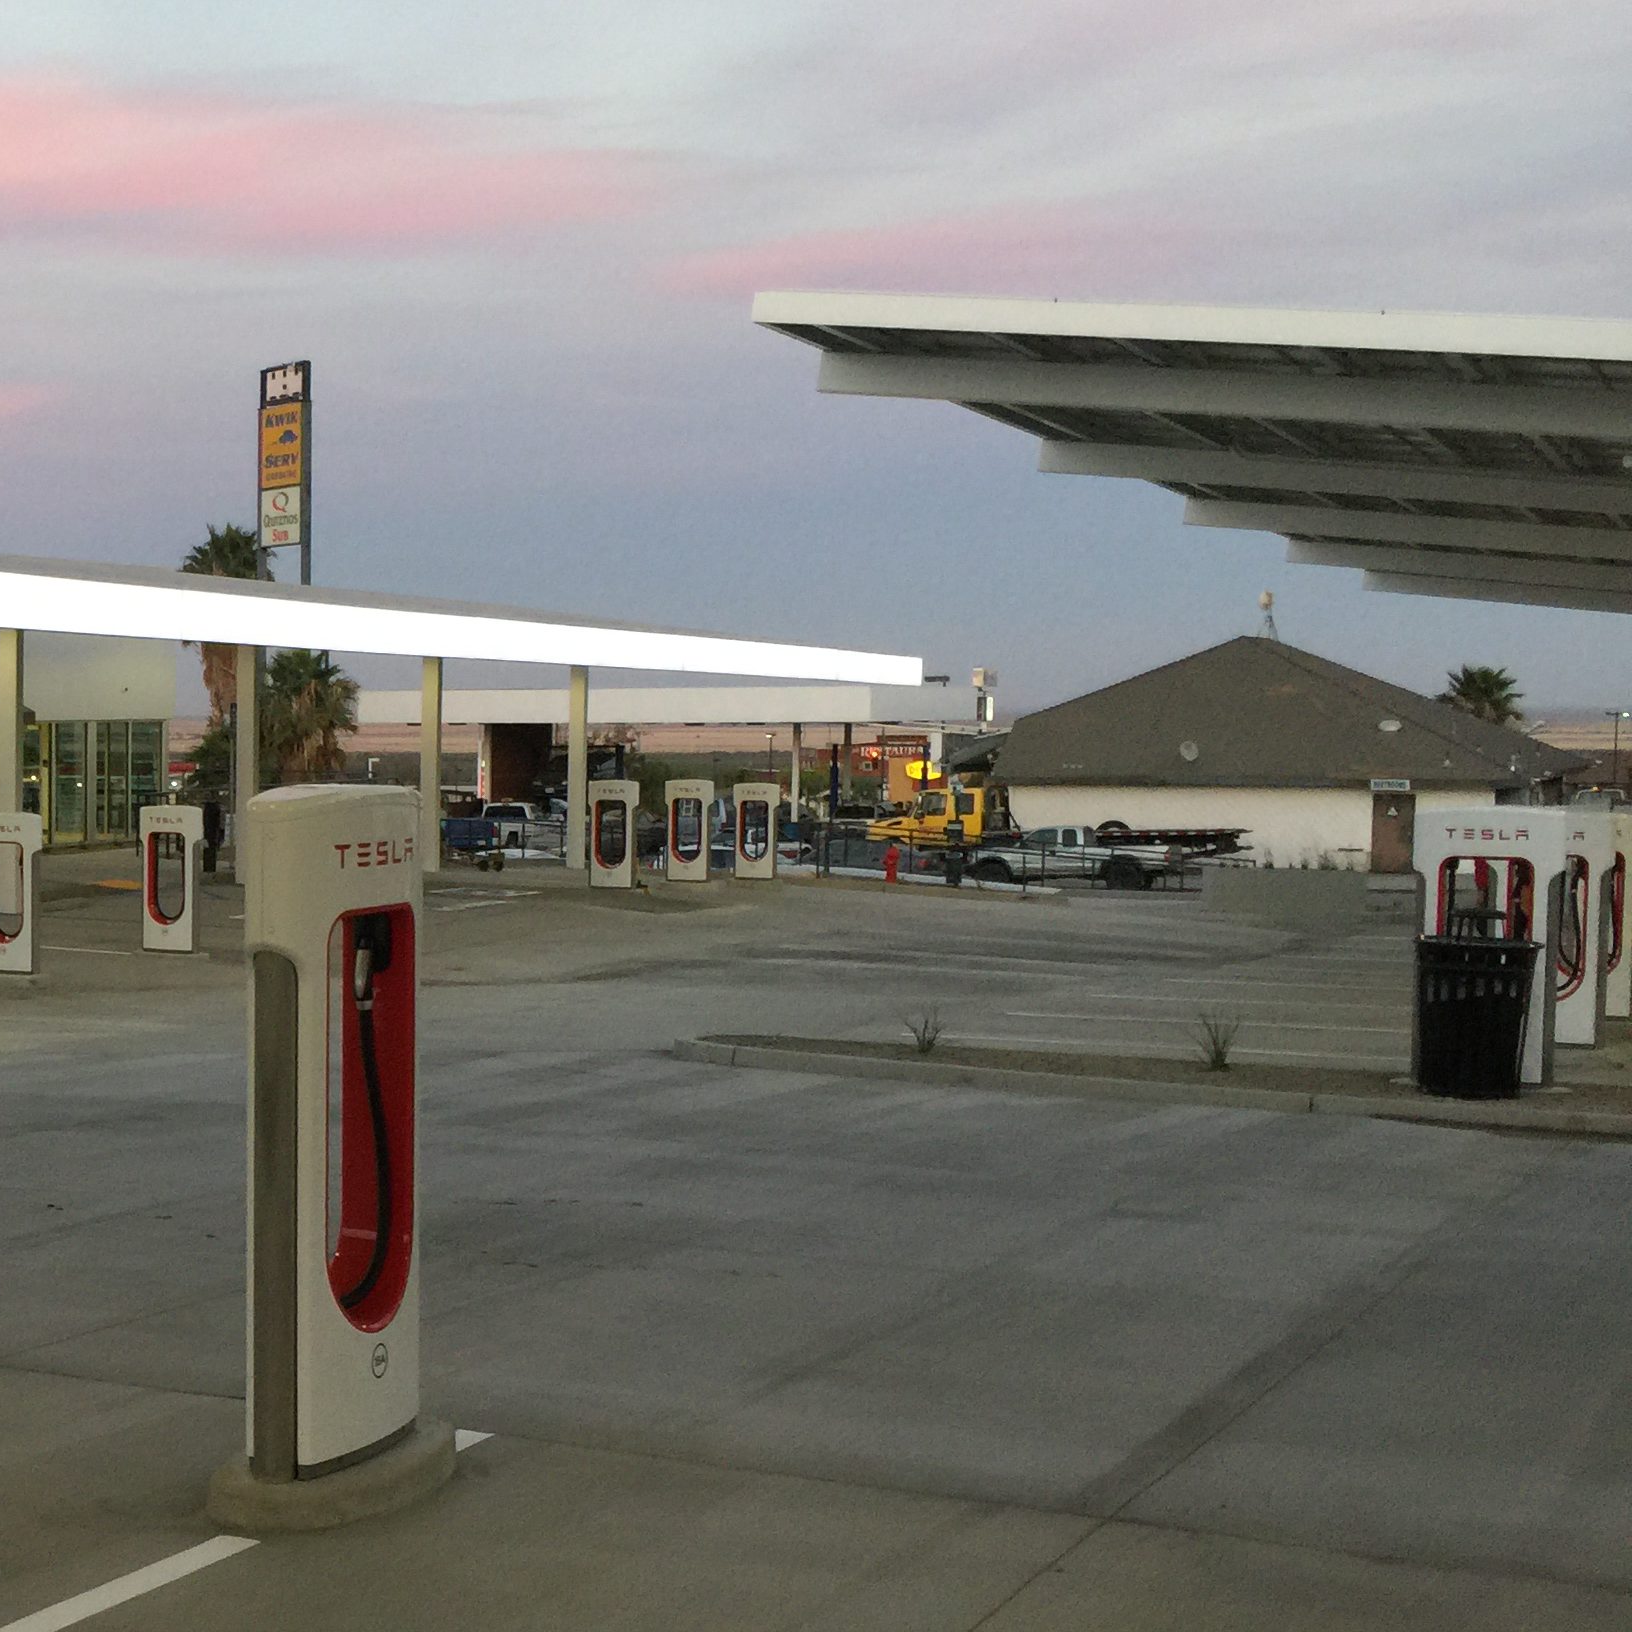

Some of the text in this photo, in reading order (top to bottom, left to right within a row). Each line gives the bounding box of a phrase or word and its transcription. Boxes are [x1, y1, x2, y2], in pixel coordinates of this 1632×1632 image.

[265, 411, 298, 428] KWIK
[264, 452, 299, 469] SERV
[1445, 828, 1530, 841] TESLA
[334, 838, 414, 869] TESLA
